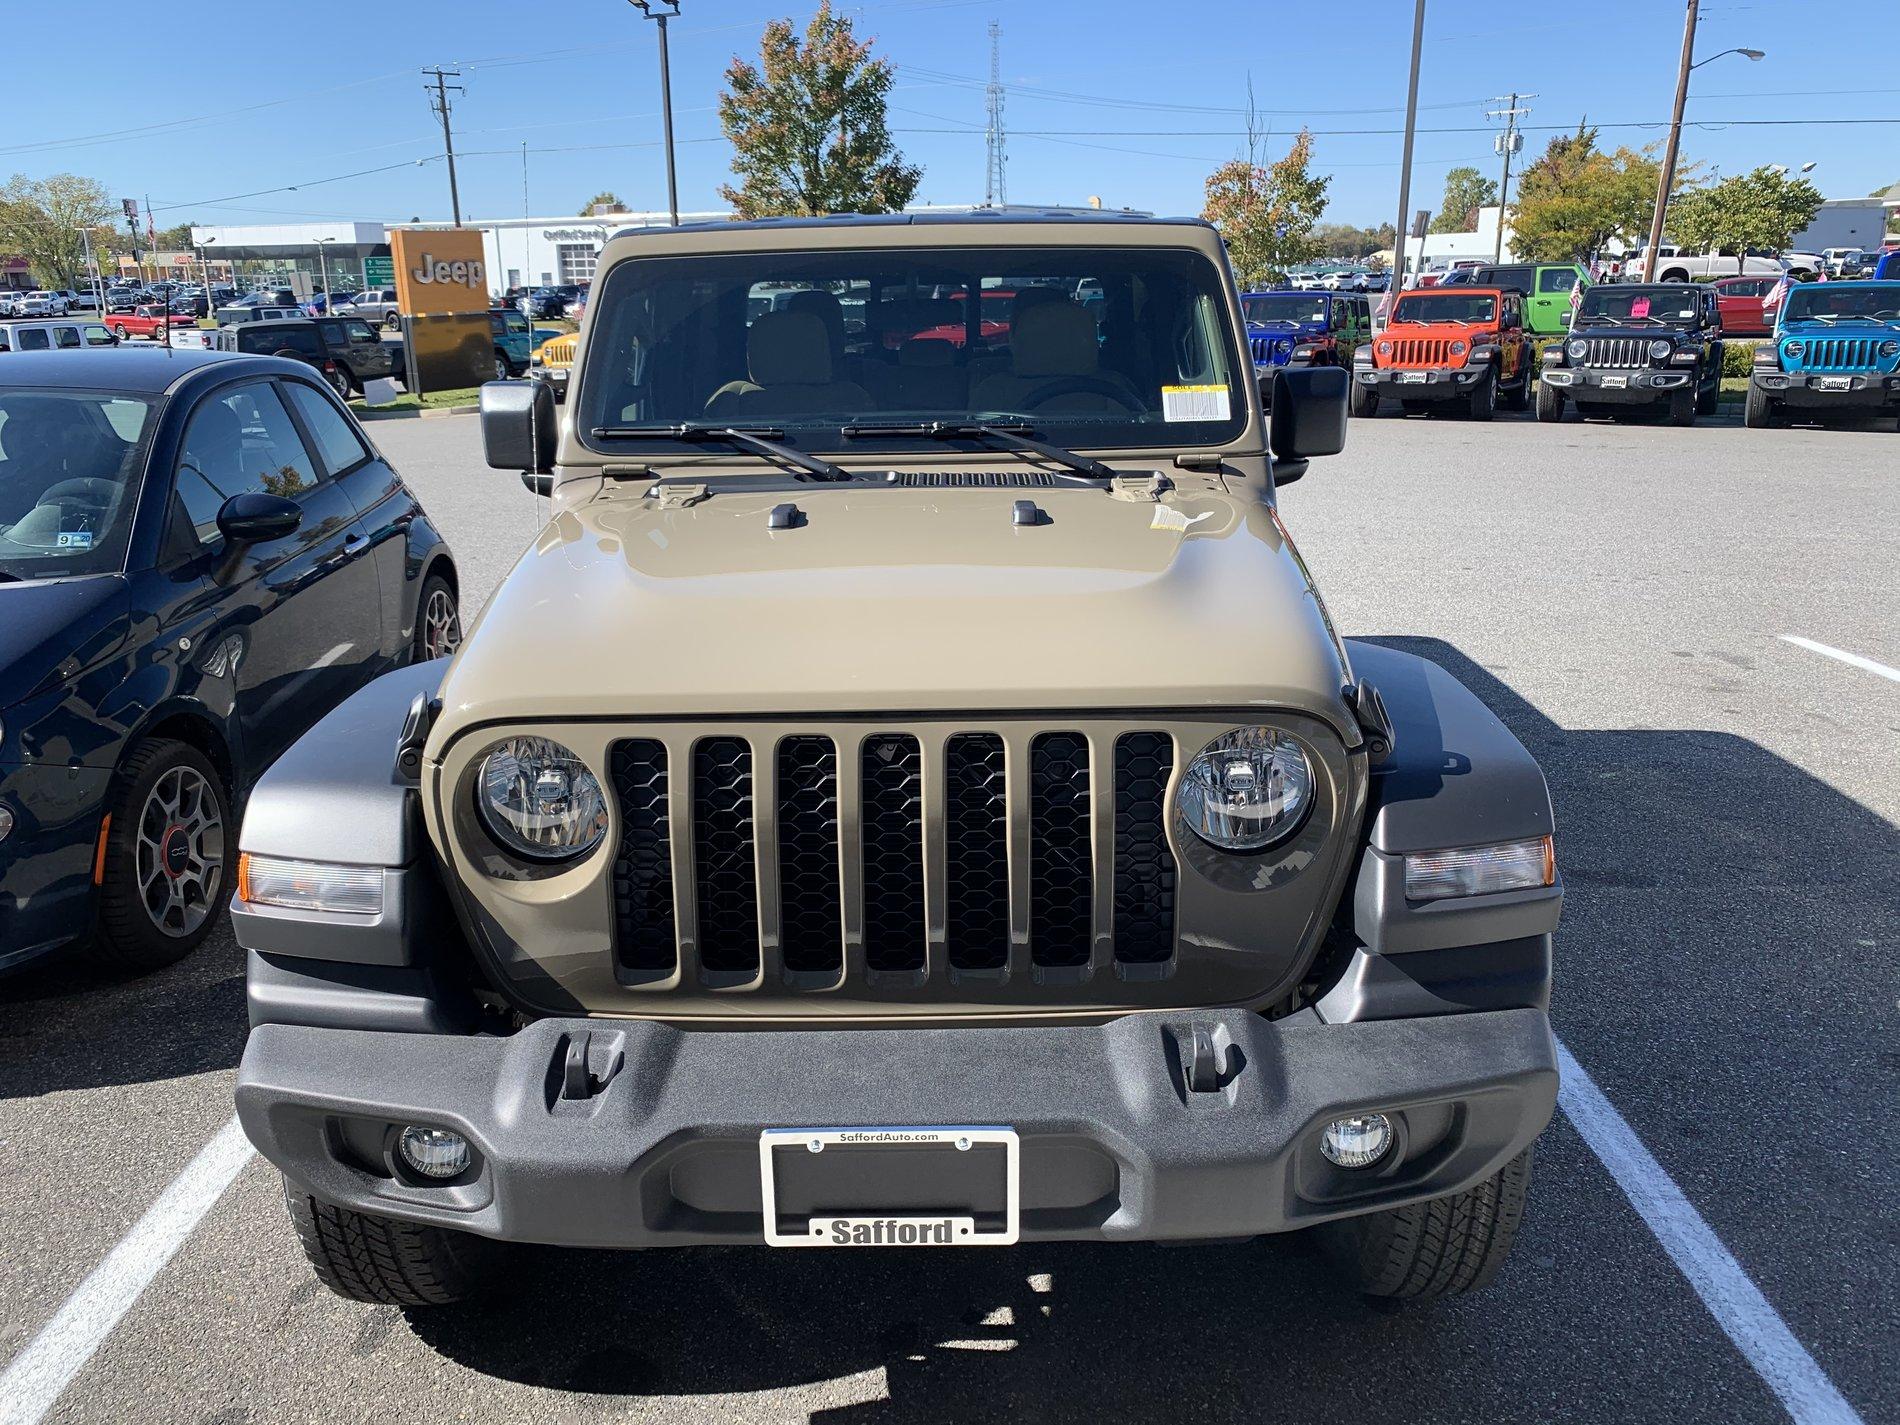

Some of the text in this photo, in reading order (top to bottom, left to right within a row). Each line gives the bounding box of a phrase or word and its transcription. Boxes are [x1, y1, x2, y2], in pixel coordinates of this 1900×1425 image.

[413, 252, 484, 289] Jeep
[60, 535, 69, 545] 9
[840, 1133, 939, 1143] SaffordAuto.com
[831, 1219, 953, 1244] Safford
